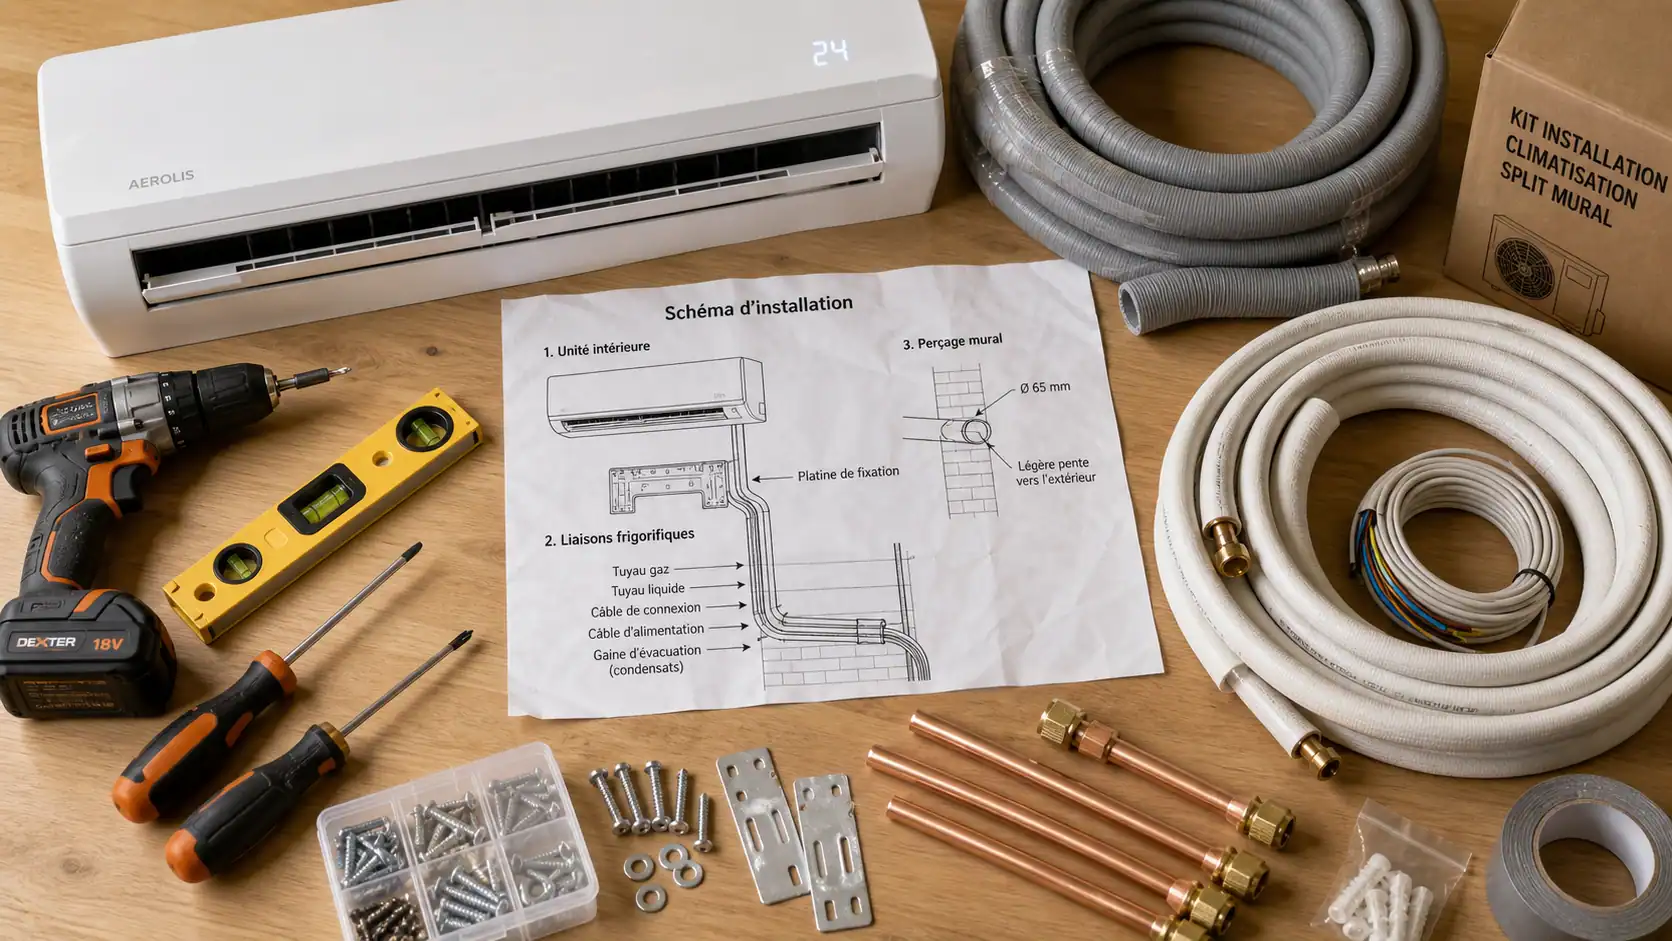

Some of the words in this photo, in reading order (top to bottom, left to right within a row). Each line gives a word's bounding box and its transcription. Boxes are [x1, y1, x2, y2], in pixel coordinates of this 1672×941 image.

[812, 39, 849, 67] 24
[1510, 106, 1539, 134] KIT
[1542, 121, 1669, 194] INSTALLATION
[128, 169, 195, 190] AEROLIS
[1506, 135, 1639, 210] CLIMATISATION
[1500, 161, 1548, 196] SPLIT
[1551, 184, 1613, 228] MURAL
[664, 300, 735, 321] Schéma
[543, 346, 554, 358] 1.
[557, 342, 590, 357] Unité
[592, 340, 651, 355] intérieure
[903, 339, 915, 351] 3.
[918, 336, 966, 350] Perçage
[969, 332, 1003, 345] mural
[1019, 382, 1030, 394] Ø
[1032, 381, 1047, 393] 65
[1050, 382, 1071, 392] mm
[797, 469, 837, 482] Platine
[839, 467, 855, 480] de
[857, 465, 900, 478] fixation
[1018, 460, 1055, 474] Légère
[1058, 459, 1090, 472] pente
[1016, 476, 1039, 487] vers
[1042, 472, 1097, 485] l'extérieur
[544, 535, 557, 547] 2.
[561, 533, 613, 546] Liaisons
[616, 528, 695, 545] frigorifiques
[612, 566, 647, 579] Tuyau
[649, 566, 670, 577] gaz
[611, 585, 645, 599] Tuyau
[648, 583, 685, 597] liquide
[626, 605, 641, 616] de
[643, 602, 701, 616] connexion
[623, 623, 705, 638] d'alimentation
[16, 637, 77, 648] DEXTER
[92, 638, 124, 651] 18V
[593, 648, 626, 661] Gaine
[629, 645, 702, 660] d'évacuation
[609, 661, 684, 678] (condensats)
